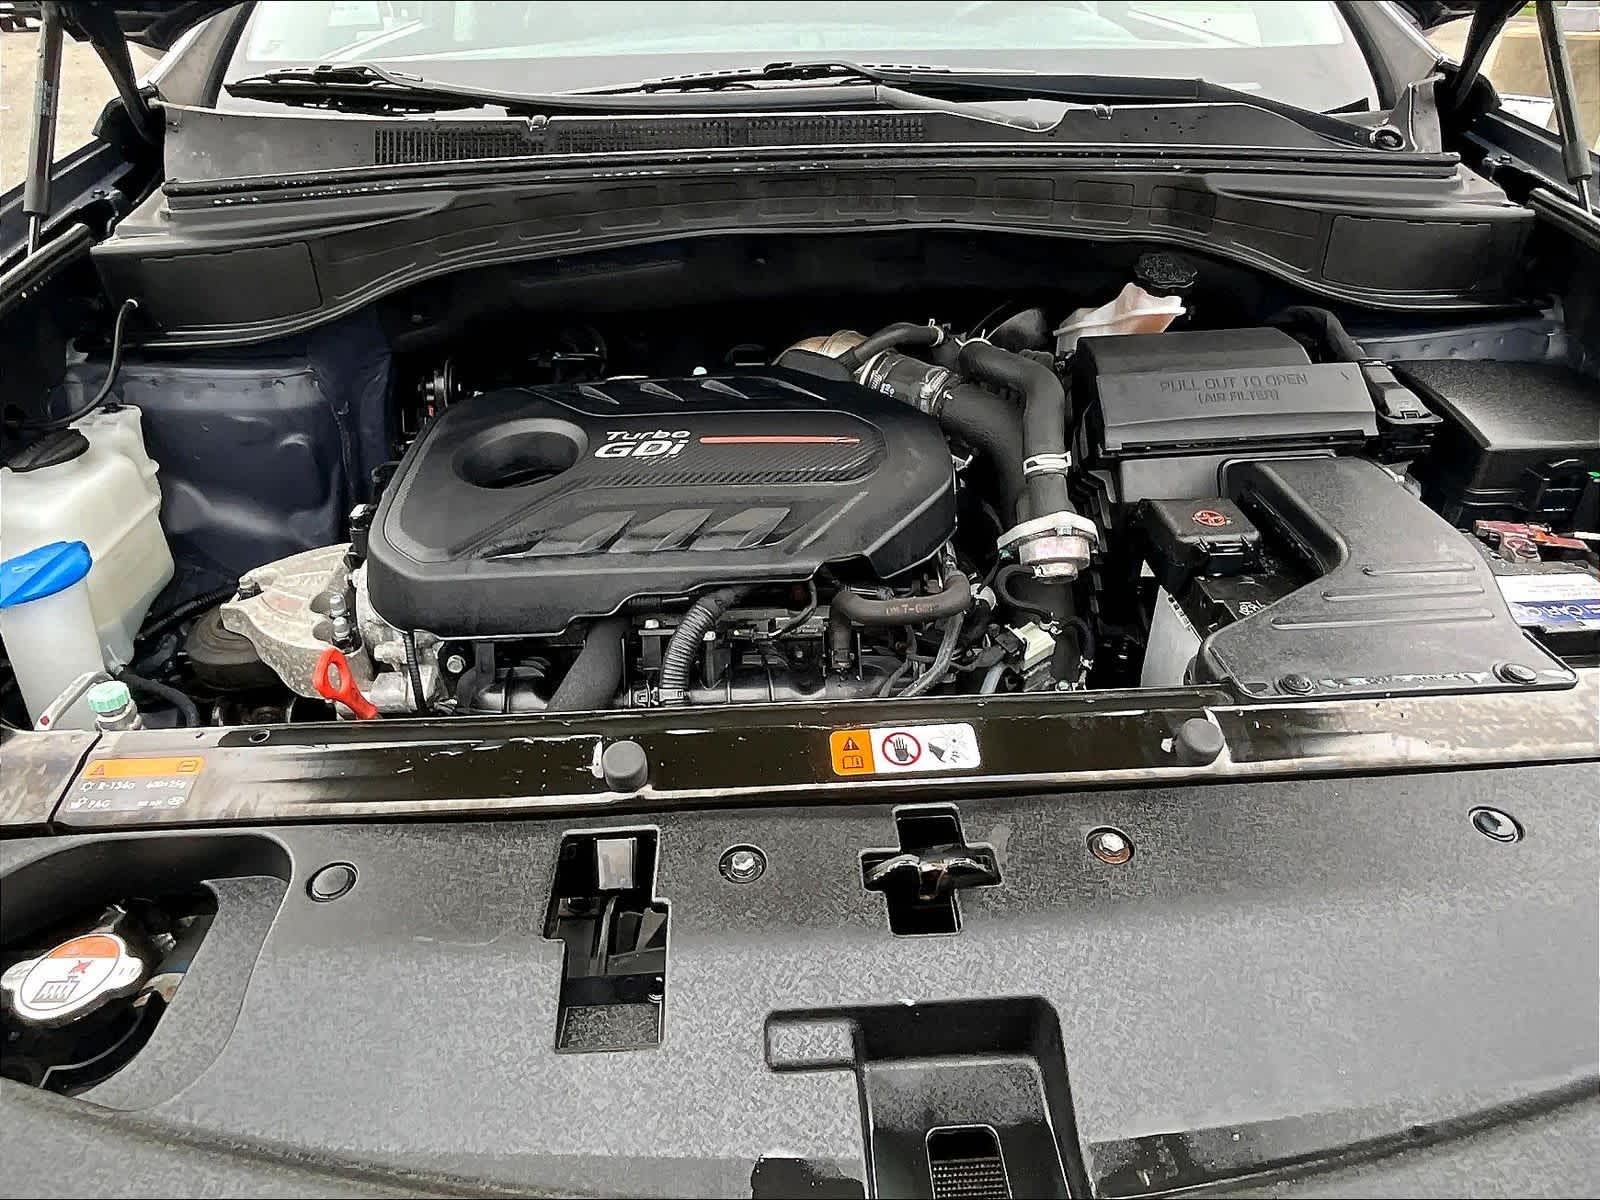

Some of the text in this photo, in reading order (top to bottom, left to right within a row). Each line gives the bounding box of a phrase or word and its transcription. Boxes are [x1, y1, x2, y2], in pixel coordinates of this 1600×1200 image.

[1160, 372, 1309, 393] PULL OUT TO OPEN
[606, 429, 691, 441] Turbo
[594, 439, 690, 458] GDi
